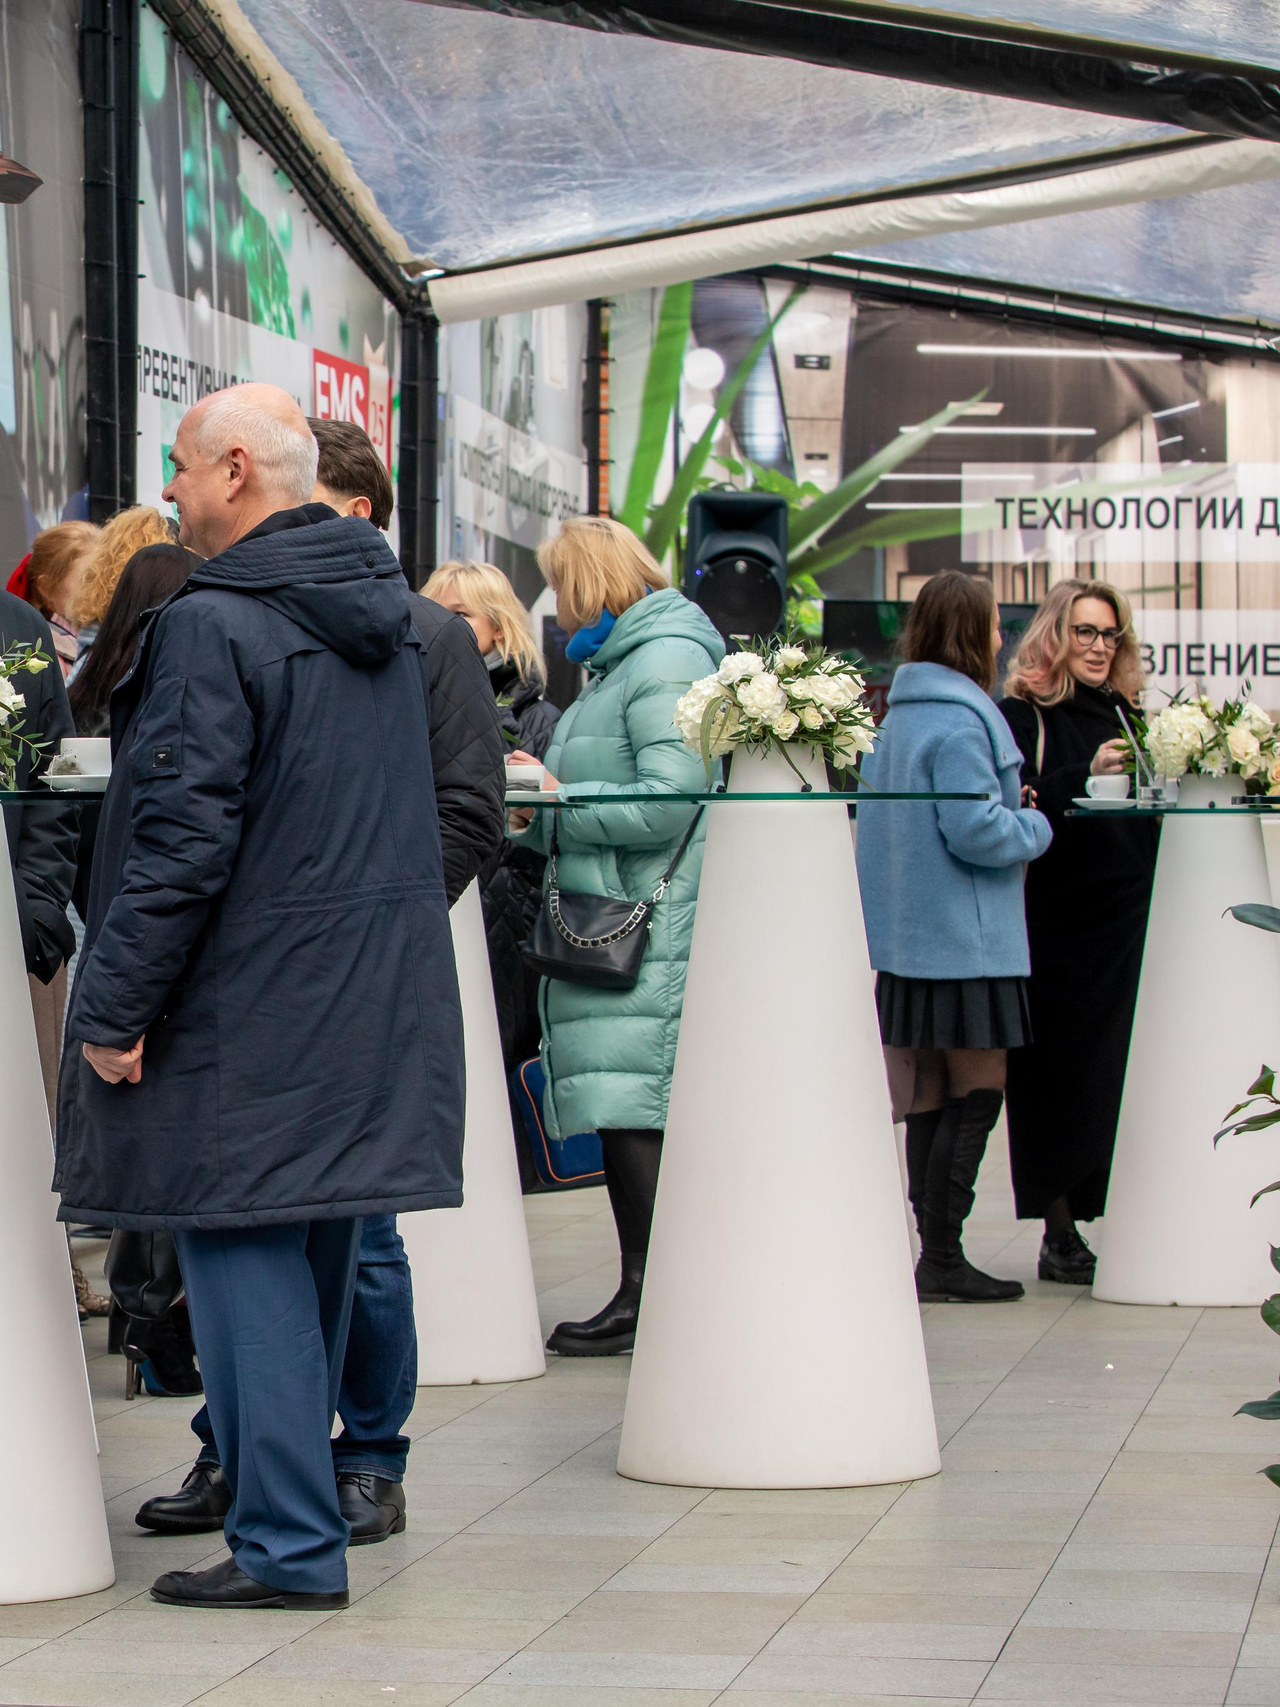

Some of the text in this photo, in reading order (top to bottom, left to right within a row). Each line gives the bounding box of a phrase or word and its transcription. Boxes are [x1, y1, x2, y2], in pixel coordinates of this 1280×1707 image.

[136, 344, 237, 406] РЕВЕНТИВН
[316, 362, 365, 431] EMS
[995, 497, 1244, 530] ТЕХНОЛОГИИ
